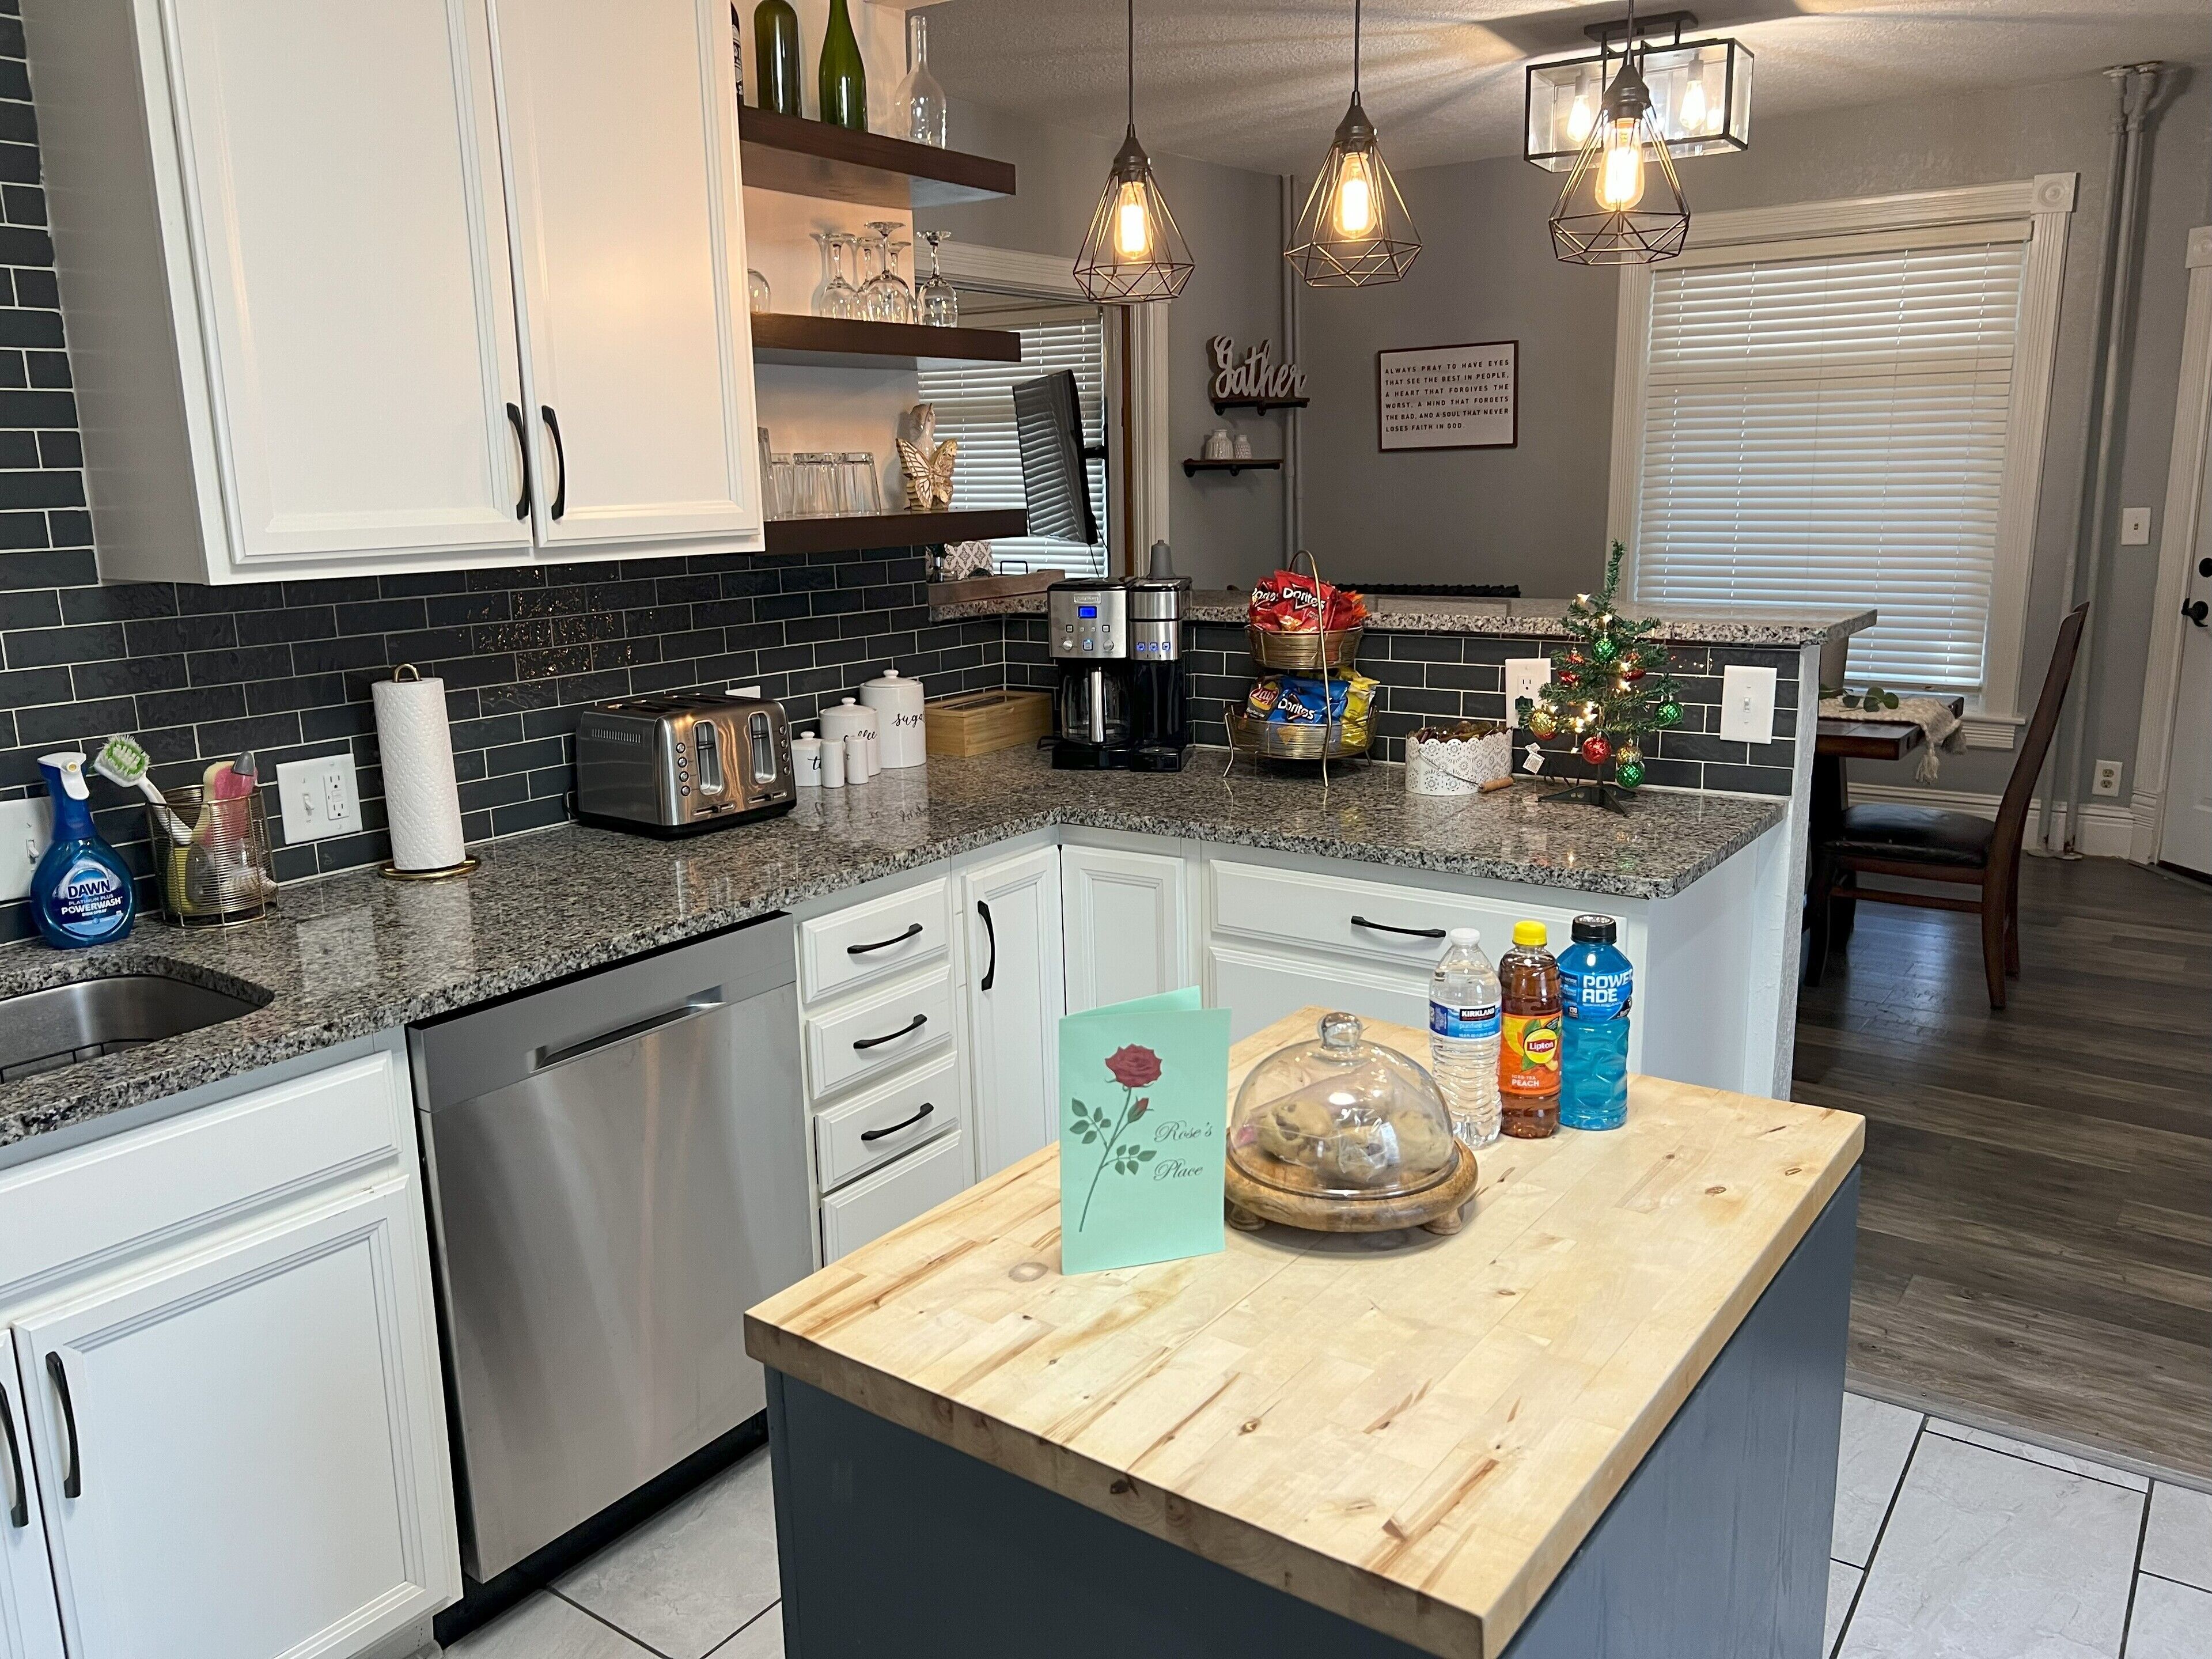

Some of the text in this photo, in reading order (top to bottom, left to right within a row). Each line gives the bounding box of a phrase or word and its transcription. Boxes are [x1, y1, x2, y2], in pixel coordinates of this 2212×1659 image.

[1214, 335, 1308, 398] Gather
[1449, 385, 1488, 393] FORGIVES
[1283, 588, 1326, 609] Doritos
[1278, 698, 1315, 719] Doritos
[67, 880, 111, 899] DAWN
[69, 897, 100, 906] PLATINUM
[1582, 988, 1618, 1003] ADE
[1461, 1007, 1495, 1017] KIRKLAND
[1529, 1041, 1554, 1051] Lipton
[1512, 1079, 1540, 1087] PEACH
[1154, 1120, 1213, 1143] Rose's
[1153, 1158, 1203, 1181] Place
